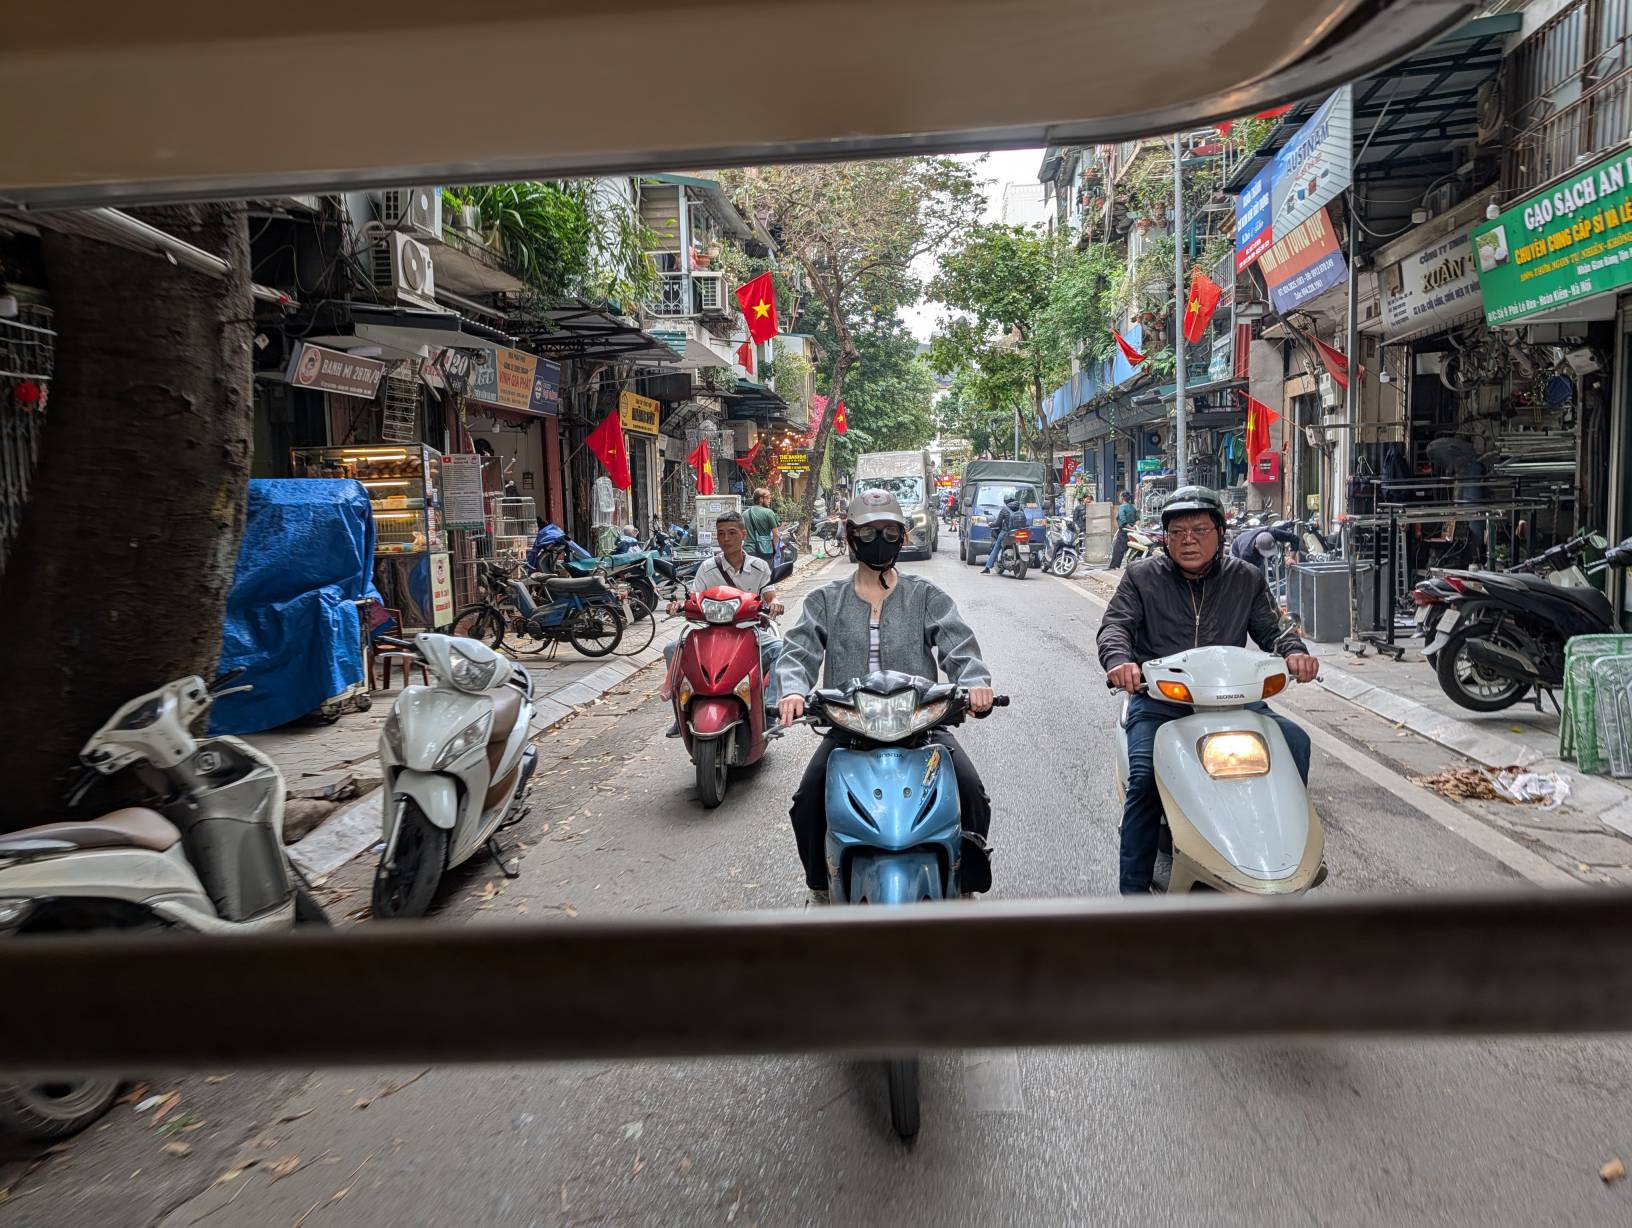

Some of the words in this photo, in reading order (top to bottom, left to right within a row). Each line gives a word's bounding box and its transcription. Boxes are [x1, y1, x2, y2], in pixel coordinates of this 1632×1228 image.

[1287, 121, 1330, 175] AUSTNAM
[1524, 199, 1553, 232] GẠO
[1554, 176, 1597, 218] SẠCH
[1600, 163, 1625, 197] AN
[1420, 249, 1438, 264] CÔNG
[1439, 245, 1448, 256] TY
[1515, 238, 1547, 265] CHUYÊN
[1548, 229, 1572, 252] CUNG
[1572, 216, 1592, 242] CẤP
[1605, 204, 1620, 228] VÀ
[1423, 257, 1465, 293] XUÂN
